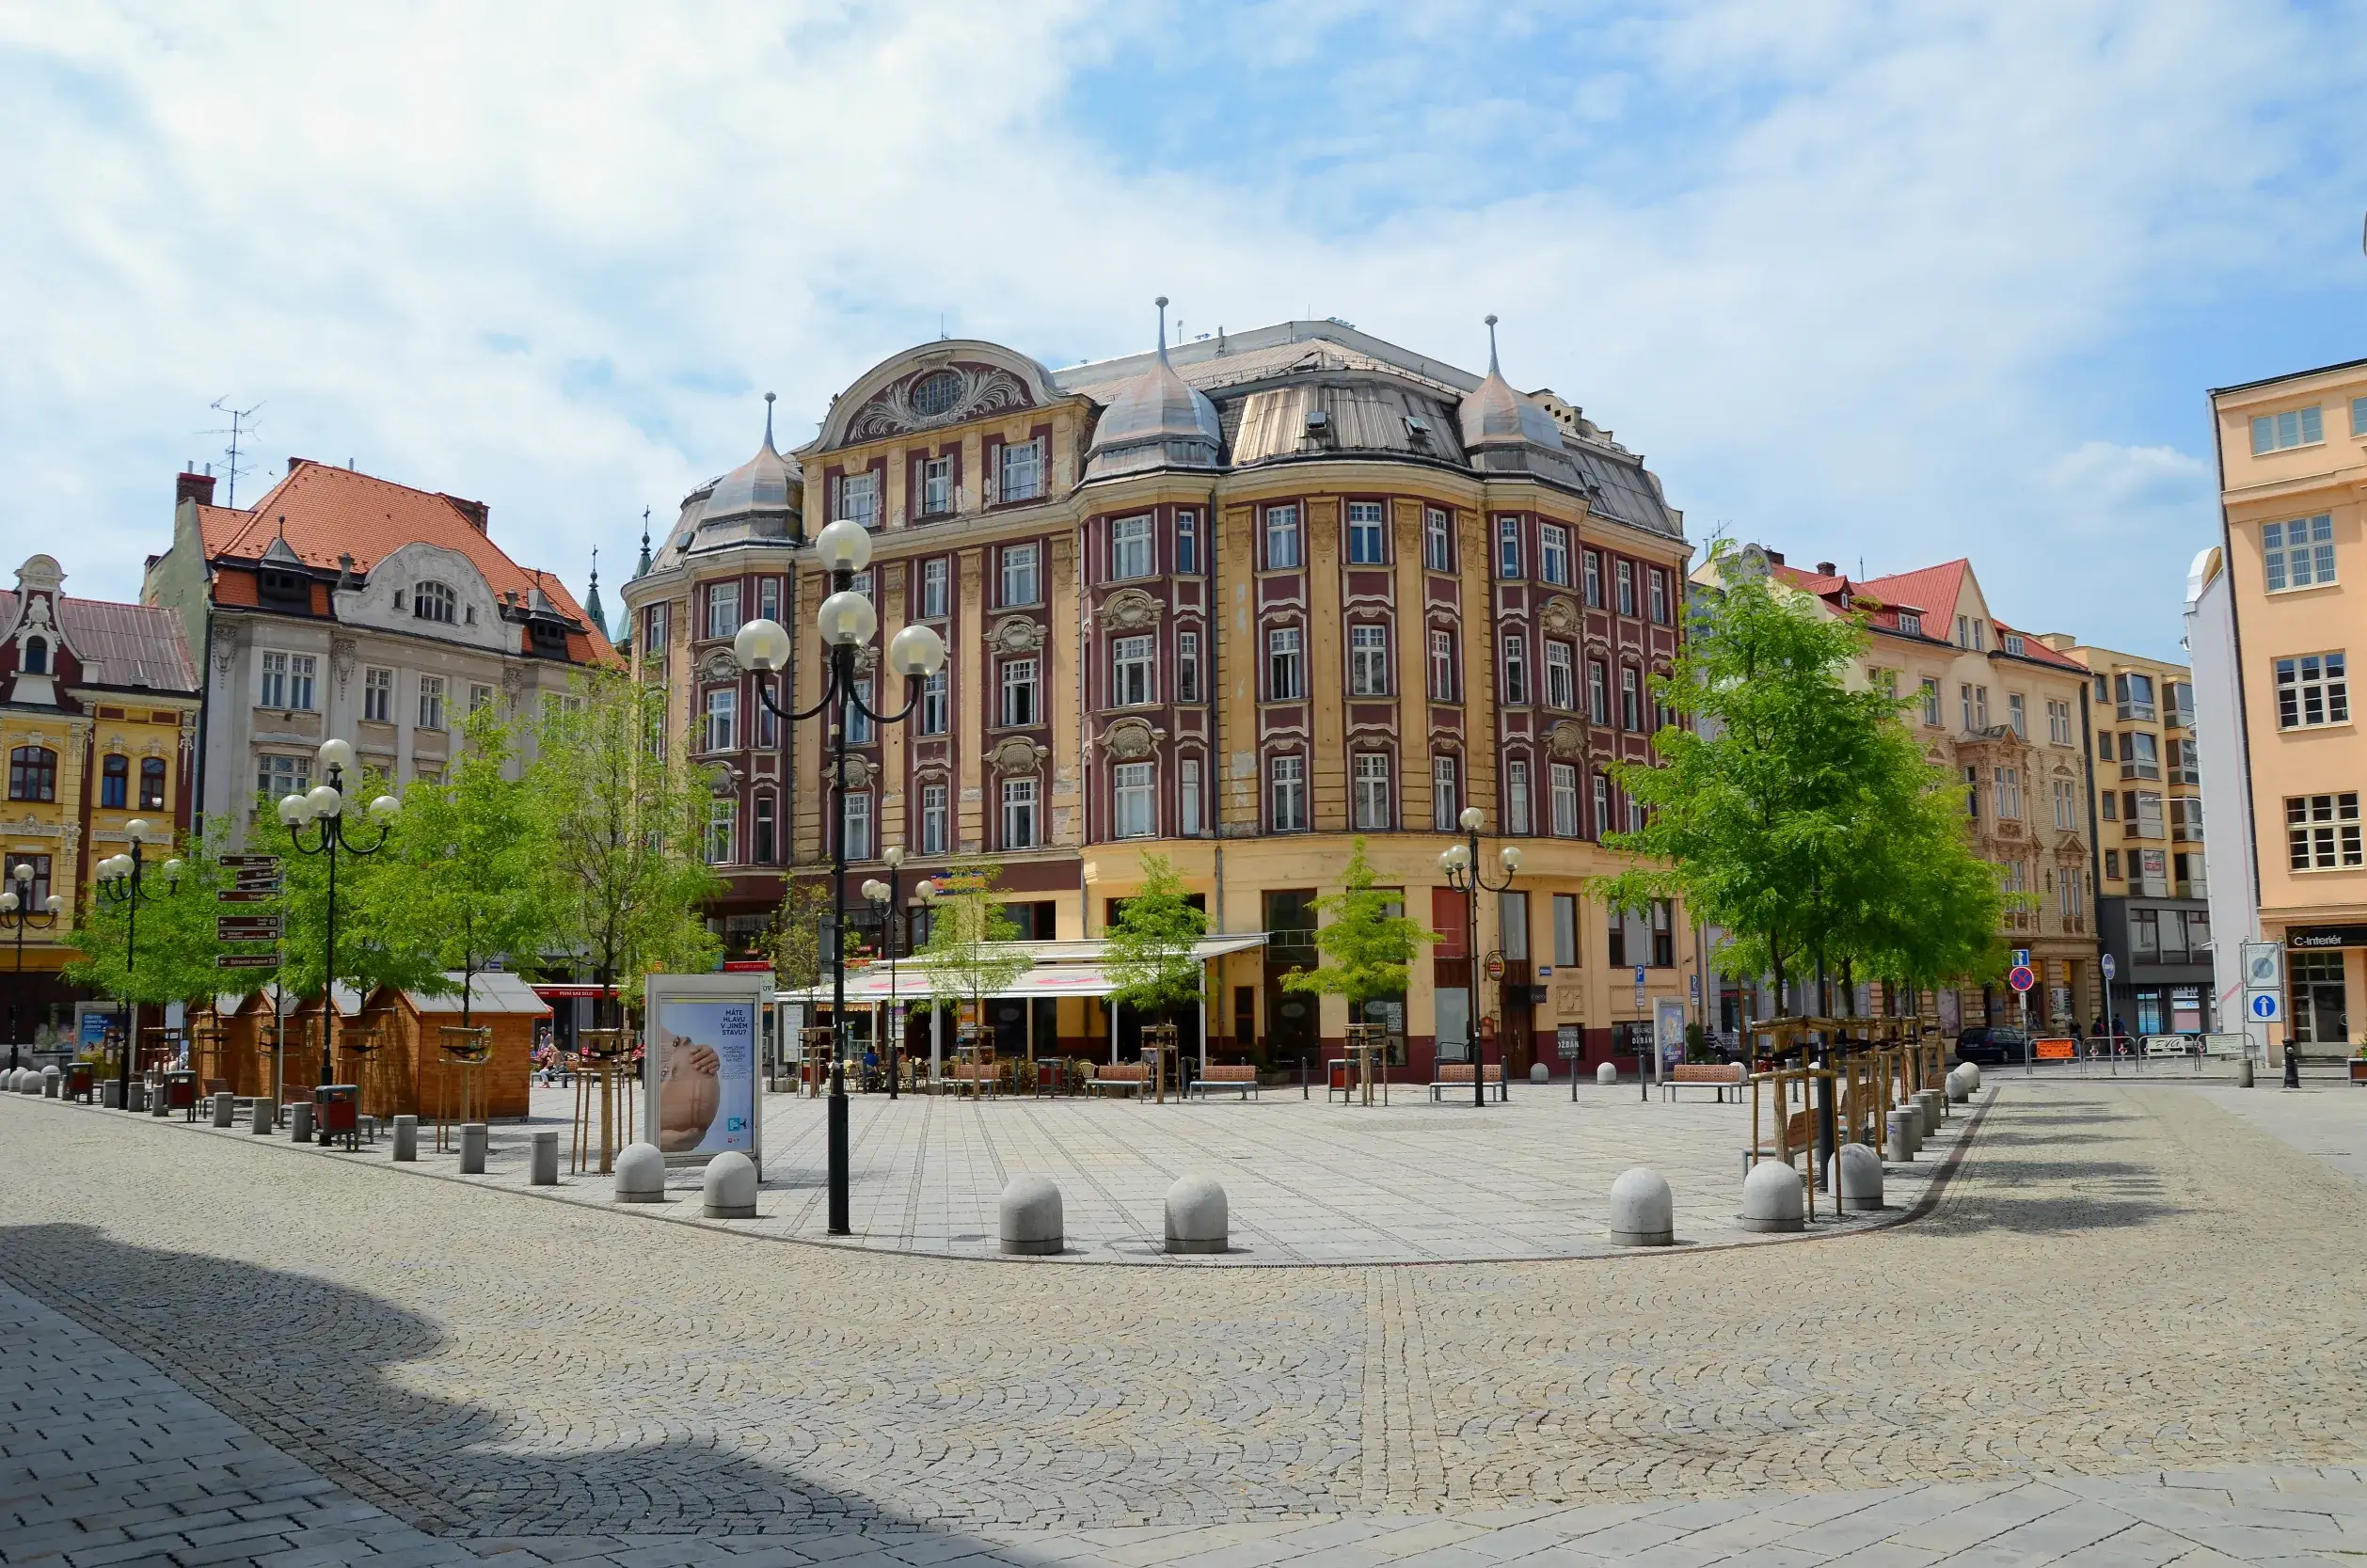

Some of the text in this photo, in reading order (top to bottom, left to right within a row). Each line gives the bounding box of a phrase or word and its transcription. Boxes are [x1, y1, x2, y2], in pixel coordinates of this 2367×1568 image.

[2294, 935, 2342, 946] C-Interiér
[1637, 966, 1644, 980] P
[2155, 1038, 2181, 1048] EVA
